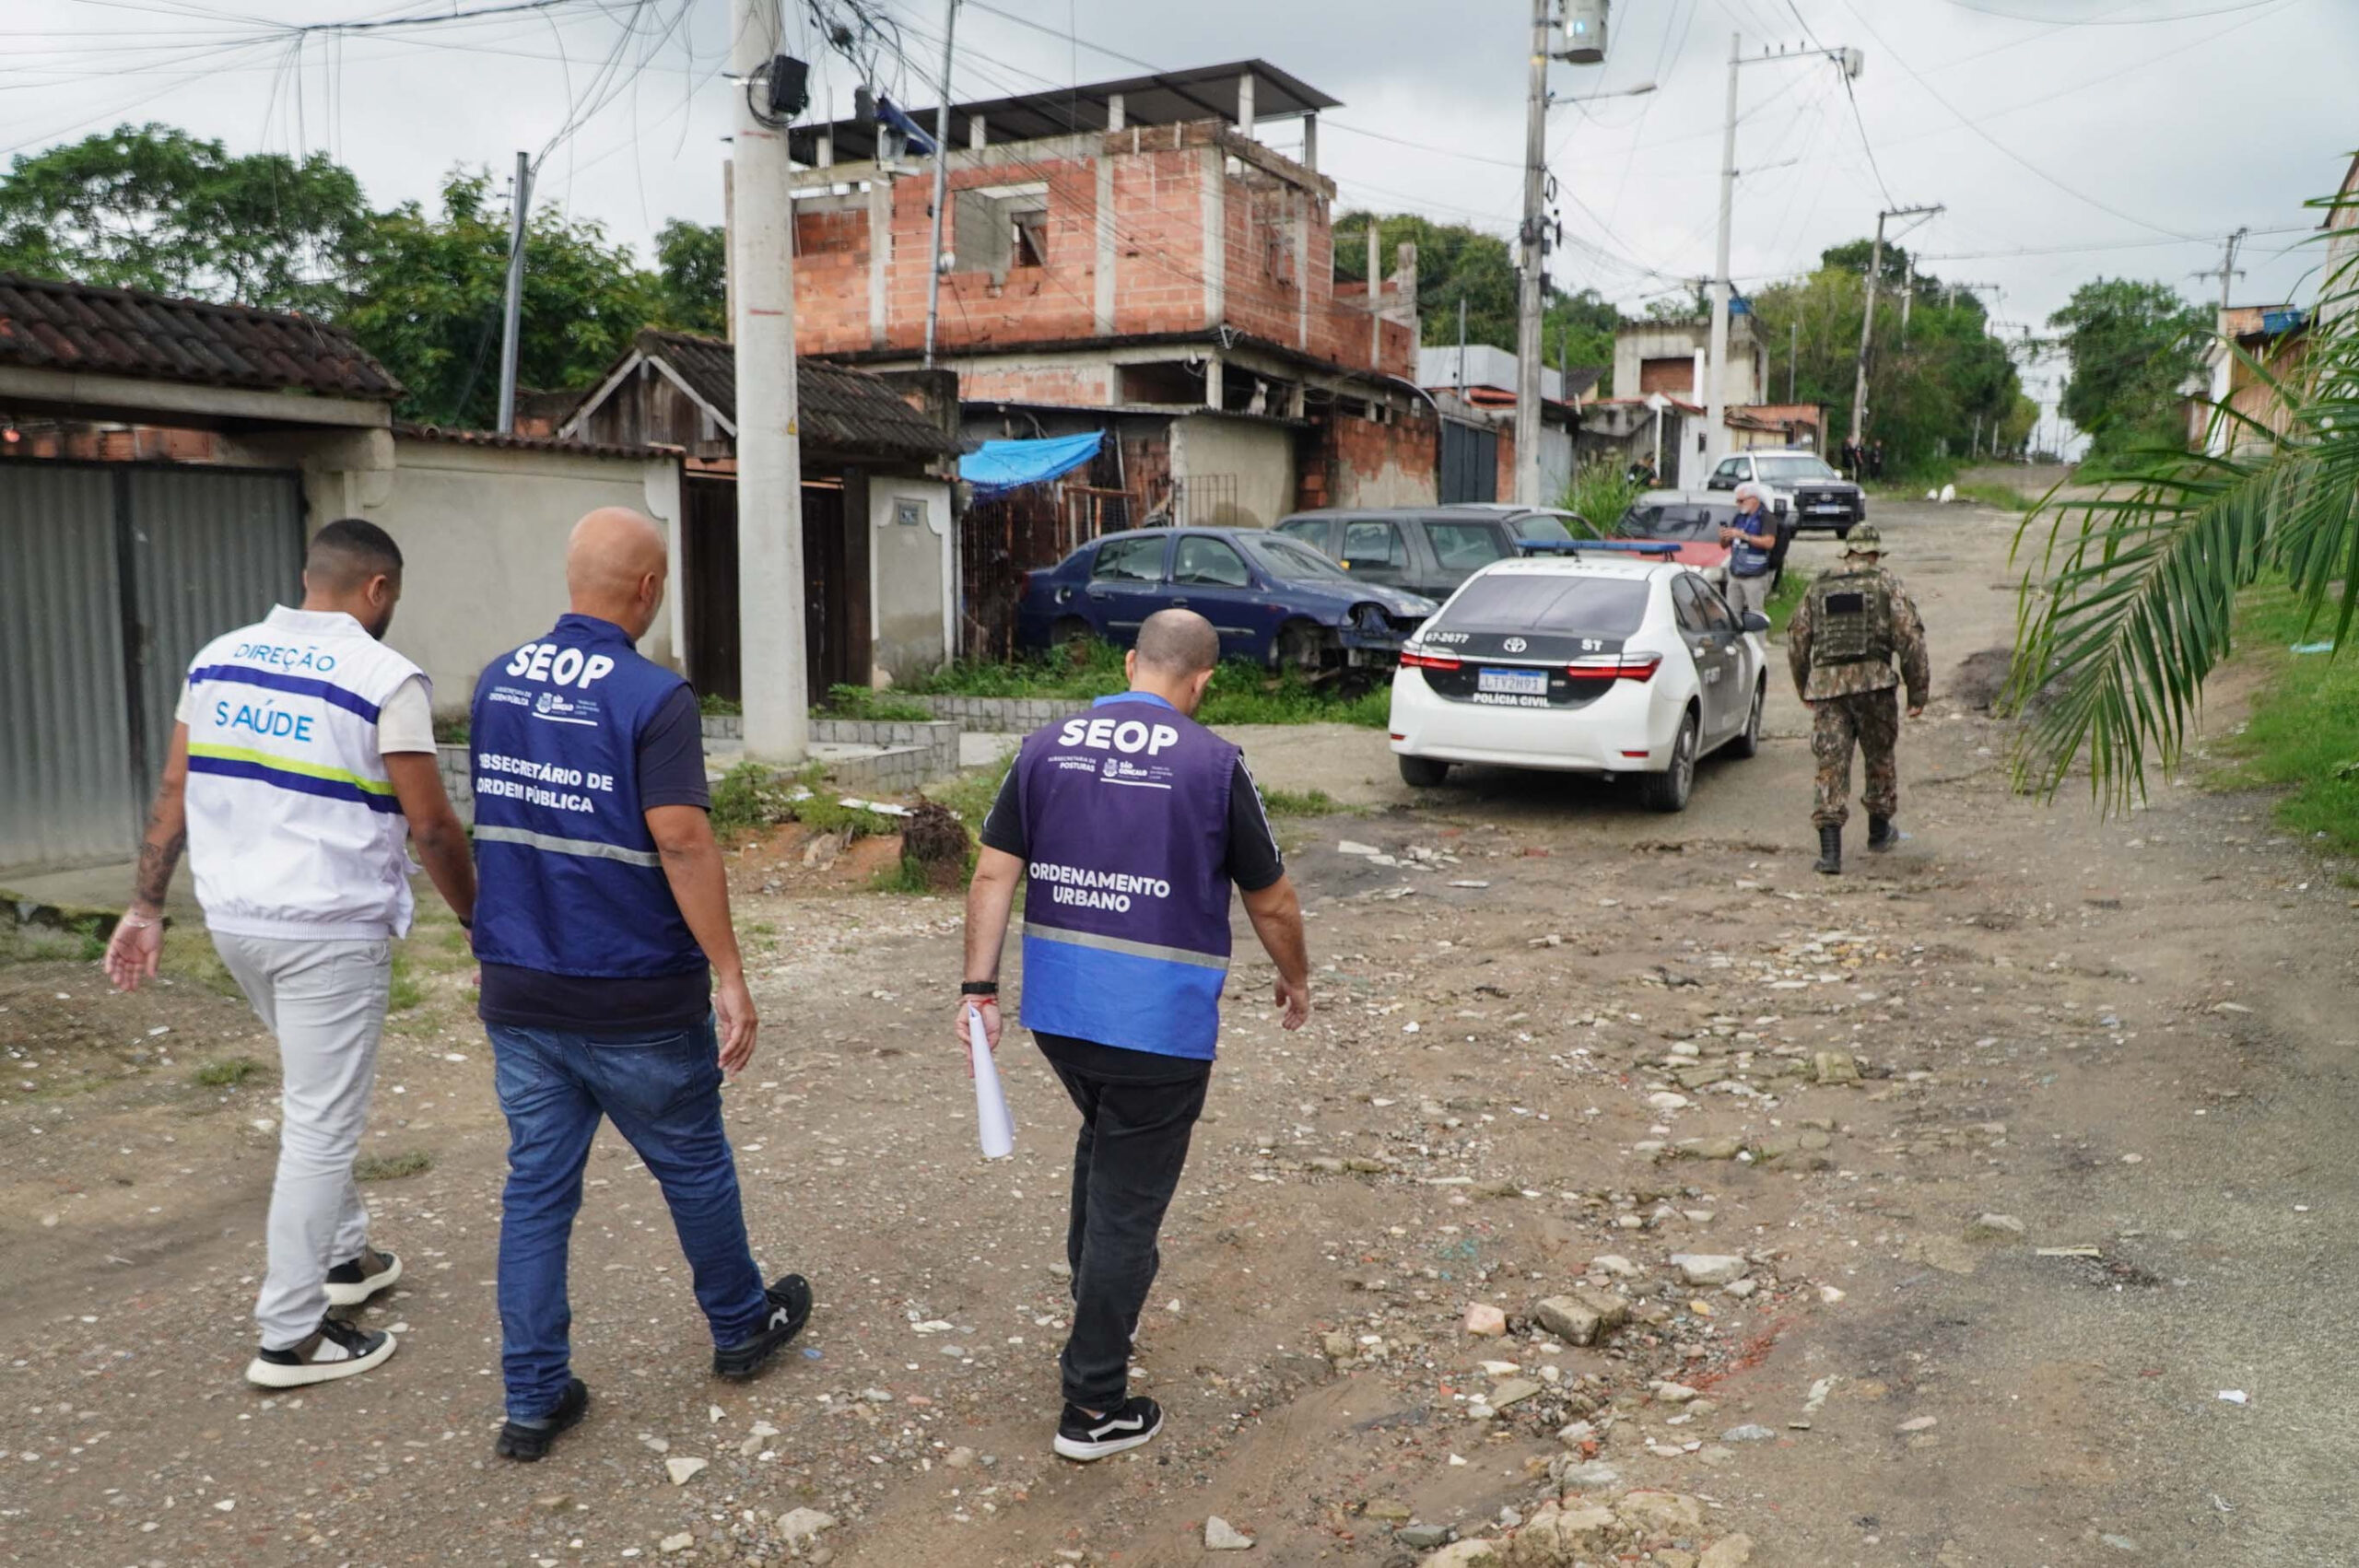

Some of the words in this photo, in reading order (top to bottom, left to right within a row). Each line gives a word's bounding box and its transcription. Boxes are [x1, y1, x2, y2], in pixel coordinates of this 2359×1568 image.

[234, 643, 335, 673] DIREÇÃO
[1581, 638, 1603, 651] ST
[506, 643, 615, 689] SEOP
[1473, 691, 1518, 706] POLÍCIA
[1519, 695, 1551, 708] CIVIL
[215, 698, 314, 743] SAÚDE
[1058, 719, 1179, 755] SEOP
[478, 753, 582, 787] BSECRETÁRIO
[586, 772, 614, 792] DE
[1060, 761, 1096, 773] POSTURAS
[476, 777, 524, 800] ORDEM
[525, 785, 594, 813] PÚBLICA
[1029, 862, 1170, 898] ORDENAMENTO
[1053, 885, 1131, 913] URBANO
